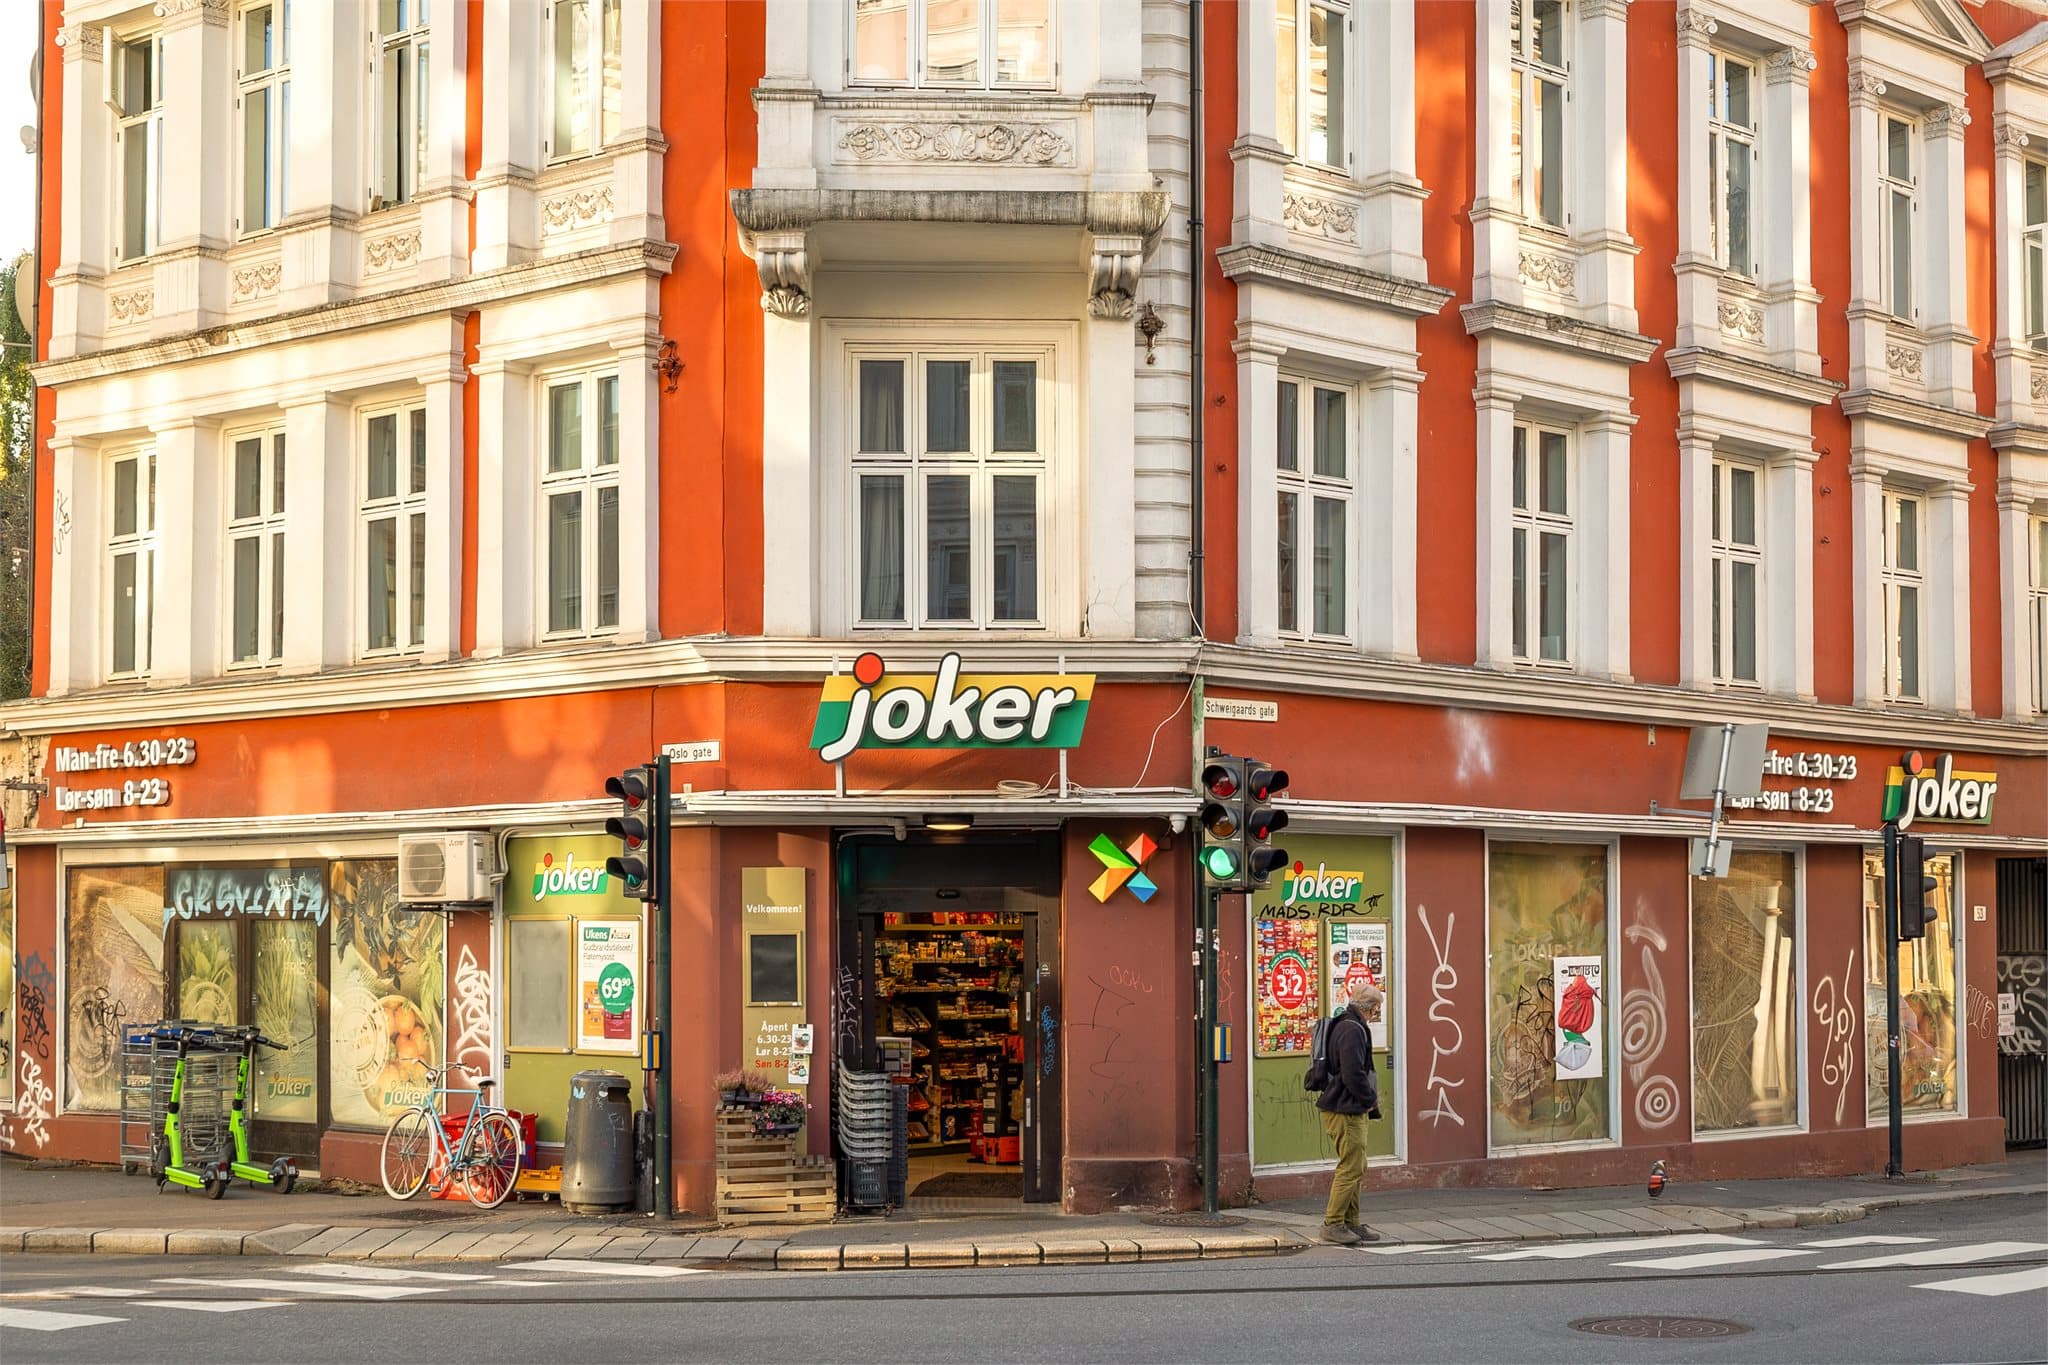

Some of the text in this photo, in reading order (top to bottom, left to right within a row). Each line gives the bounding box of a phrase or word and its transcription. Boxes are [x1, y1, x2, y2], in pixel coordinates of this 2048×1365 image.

[819, 652, 1077, 764] joker
[1205, 700, 1275, 719] Schweigaards gate
[55, 736, 192, 773] Man-fre 6.30-23
[669, 747, 712, 760] Oslo gate
[1761, 750, 1858, 780] -fre 6.30-23
[55, 777, 166, 812] Lør-søn 8-23
[1799, 786, 1834, 813] 8-23
[1897, 750, 1998, 831] joker
[535, 852, 606, 901] joker
[1284, 860, 1358, 907] joker
[746, 904, 802, 914] Velkommen!
[585, 928, 609, 940] Ukens
[756, 1034, 792, 1044] 6.30-23
[761, 1020, 788, 1033] Åpent
[755, 1060, 789, 1069] Søn 8-2
[756, 1047, 771, 1056] Lør
[269, 1072, 311, 1098] joker
